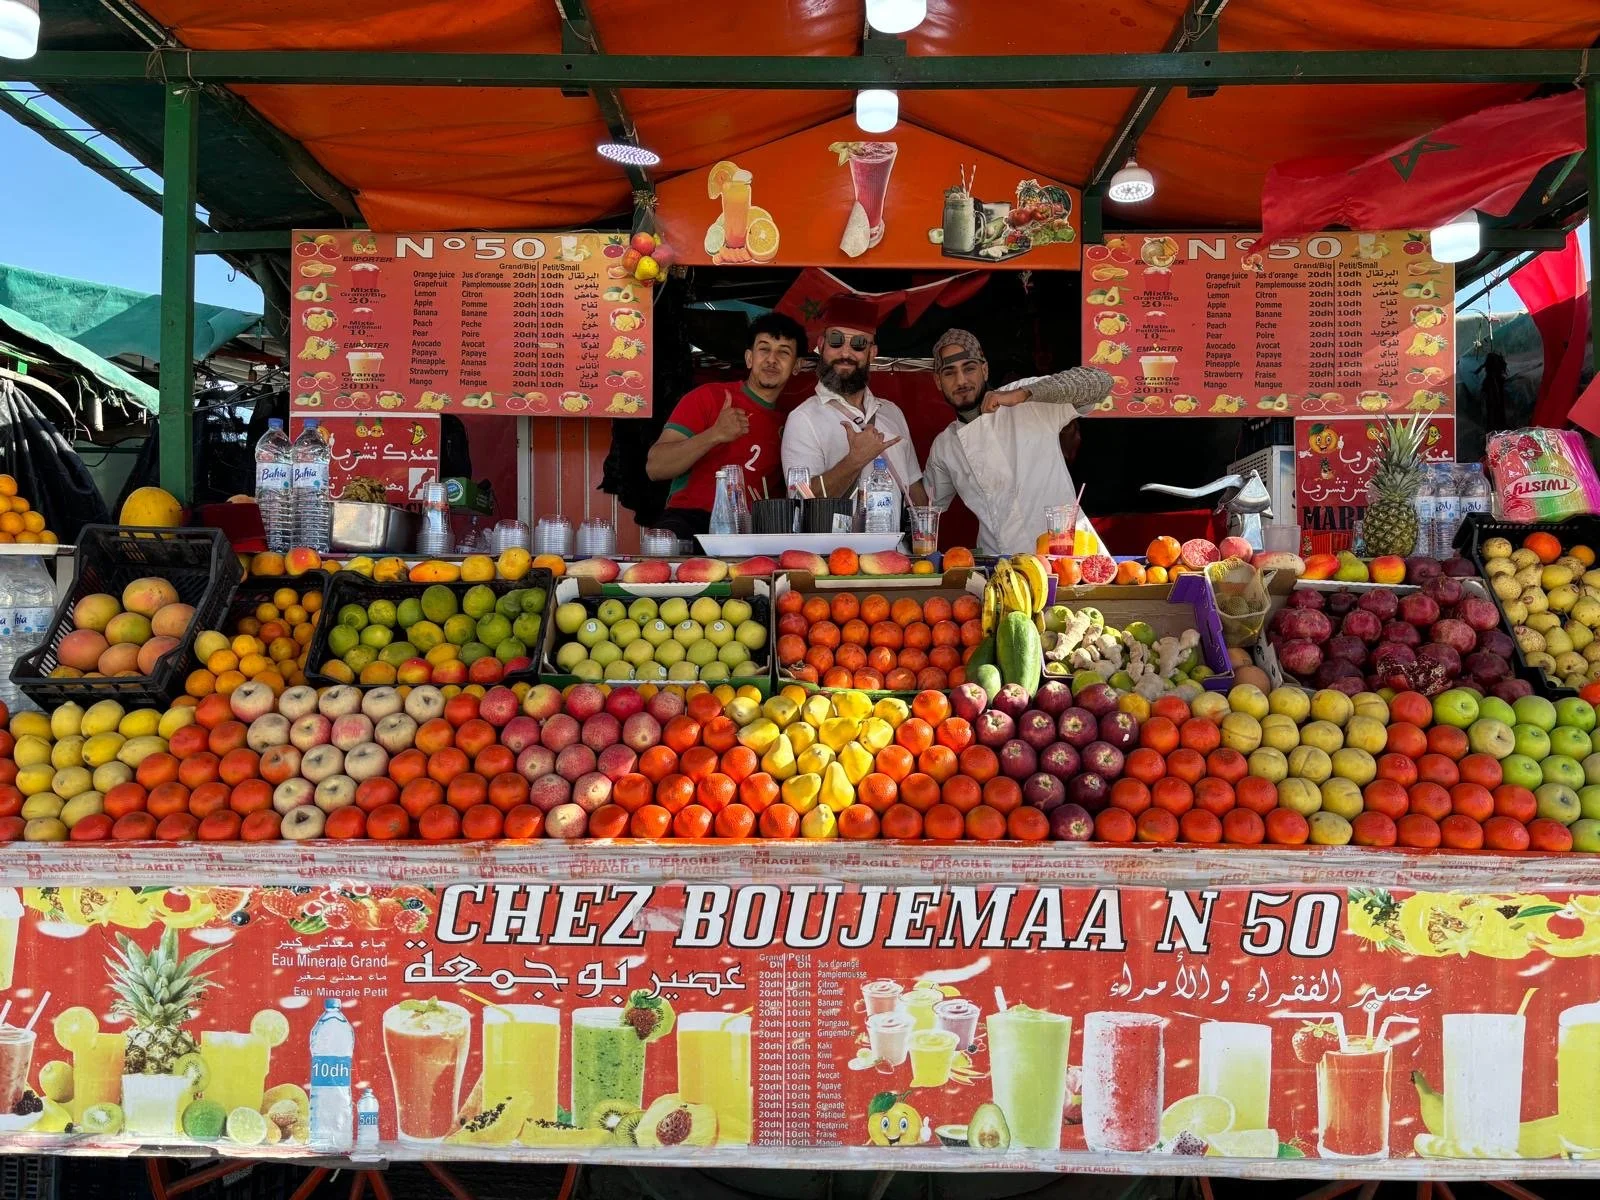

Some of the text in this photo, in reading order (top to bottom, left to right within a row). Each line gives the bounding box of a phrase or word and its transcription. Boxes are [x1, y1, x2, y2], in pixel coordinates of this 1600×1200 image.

[413, 271, 437, 279] Orange
[1231, 272, 1248, 280] juice
[1269, 272, 1298, 280] d'orange
[414, 280, 448, 288] Grapefruit
[462, 281, 511, 289] Pamplemousse
[1207, 281, 1306, 290] Grapefruit Pamplemousse
[414, 299, 432, 307] Apple
[1208, 301, 1226, 309] Apple
[462, 350, 486, 358] Papaye
[1206, 360, 1240, 368] Pineapple
[410, 368, 448, 376] Strawberry
[1204, 371, 1243, 379] Strawberry
[410, 378, 432, 386] Mango
[460, 379, 487, 387] Mangue
[1204, 381, 1227, 389] Mango
[744, 444, 762, 472] 2
[262, 468, 286, 482] Bahia
[294, 467, 316, 481] Bahia
[936, 859, 991, 869] FRAGILE
[313, 865, 368, 875] FRAGILE
[404, 865, 459, 875] FRAGILE
[494, 865, 550, 874] FRAGILE
[582, 864, 640, 874] FRAGILE
[1040, 871, 1096, 879] FRAGILE
[1319, 870, 1377, 878] FRAGILE
[435, 883, 1342, 958] CHEZ BOUJEMAA N 50
[275, 937, 303, 949] كبير
[361, 938, 386, 948] ماء
[272, 953, 293, 966] Eau
[351, 955, 387, 967] Grand
[818, 960, 828, 968] Jus
[818, 971, 867, 979] Pamplemousse
[818, 980, 839, 988] Citron
[1246, 966, 1342, 1008] الفقراء
[294, 987, 312, 996] Eau
[364, 988, 387, 996] Petit
[1348, 982, 1432, 1009] عصير
[818, 1020, 849, 1028] Pruneaux
[818, 1029, 855, 1037] Gingembre
[312, 1063, 349, 1077] 10dh
[817, 1082, 841, 1090] Papaye
[360, 1114, 377, 1125] 5dh
